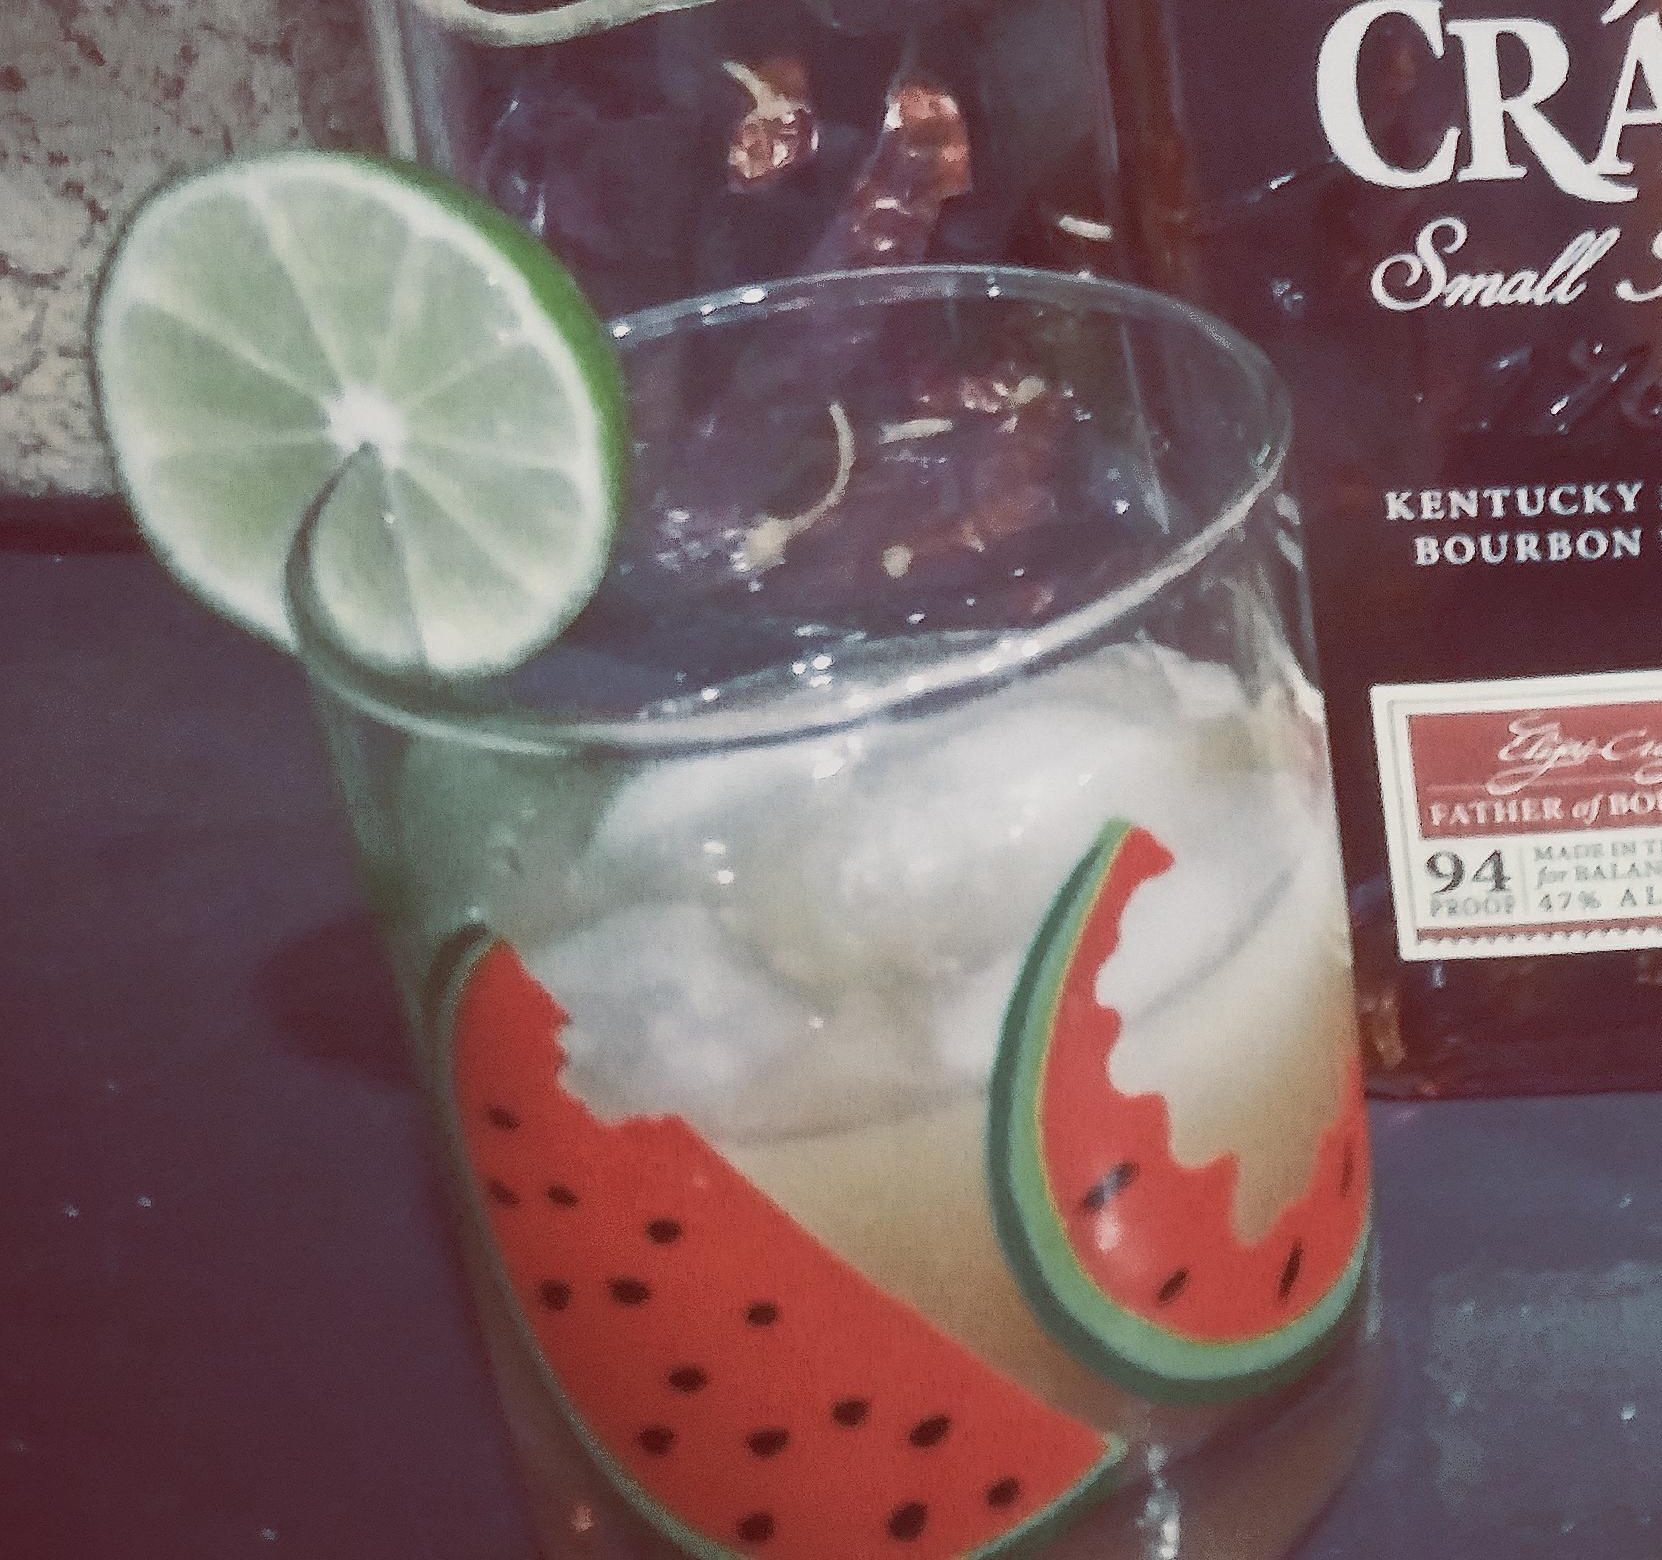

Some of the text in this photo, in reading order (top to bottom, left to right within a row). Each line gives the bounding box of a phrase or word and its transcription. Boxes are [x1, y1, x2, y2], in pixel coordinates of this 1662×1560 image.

[1370, 217, 1622, 311] Small
[1384, 480, 1644, 521] KENTUCKY
[1414, 526, 1644, 567] BOURBON
[1429, 795, 1563, 827] FATHER
[1572, 793, 1601, 825] of
[1534, 843, 1602, 861] MADE
[1425, 848, 1512, 894] 94
[1430, 893, 1515, 918] PROOF
[1538, 889, 1603, 914] 47%
